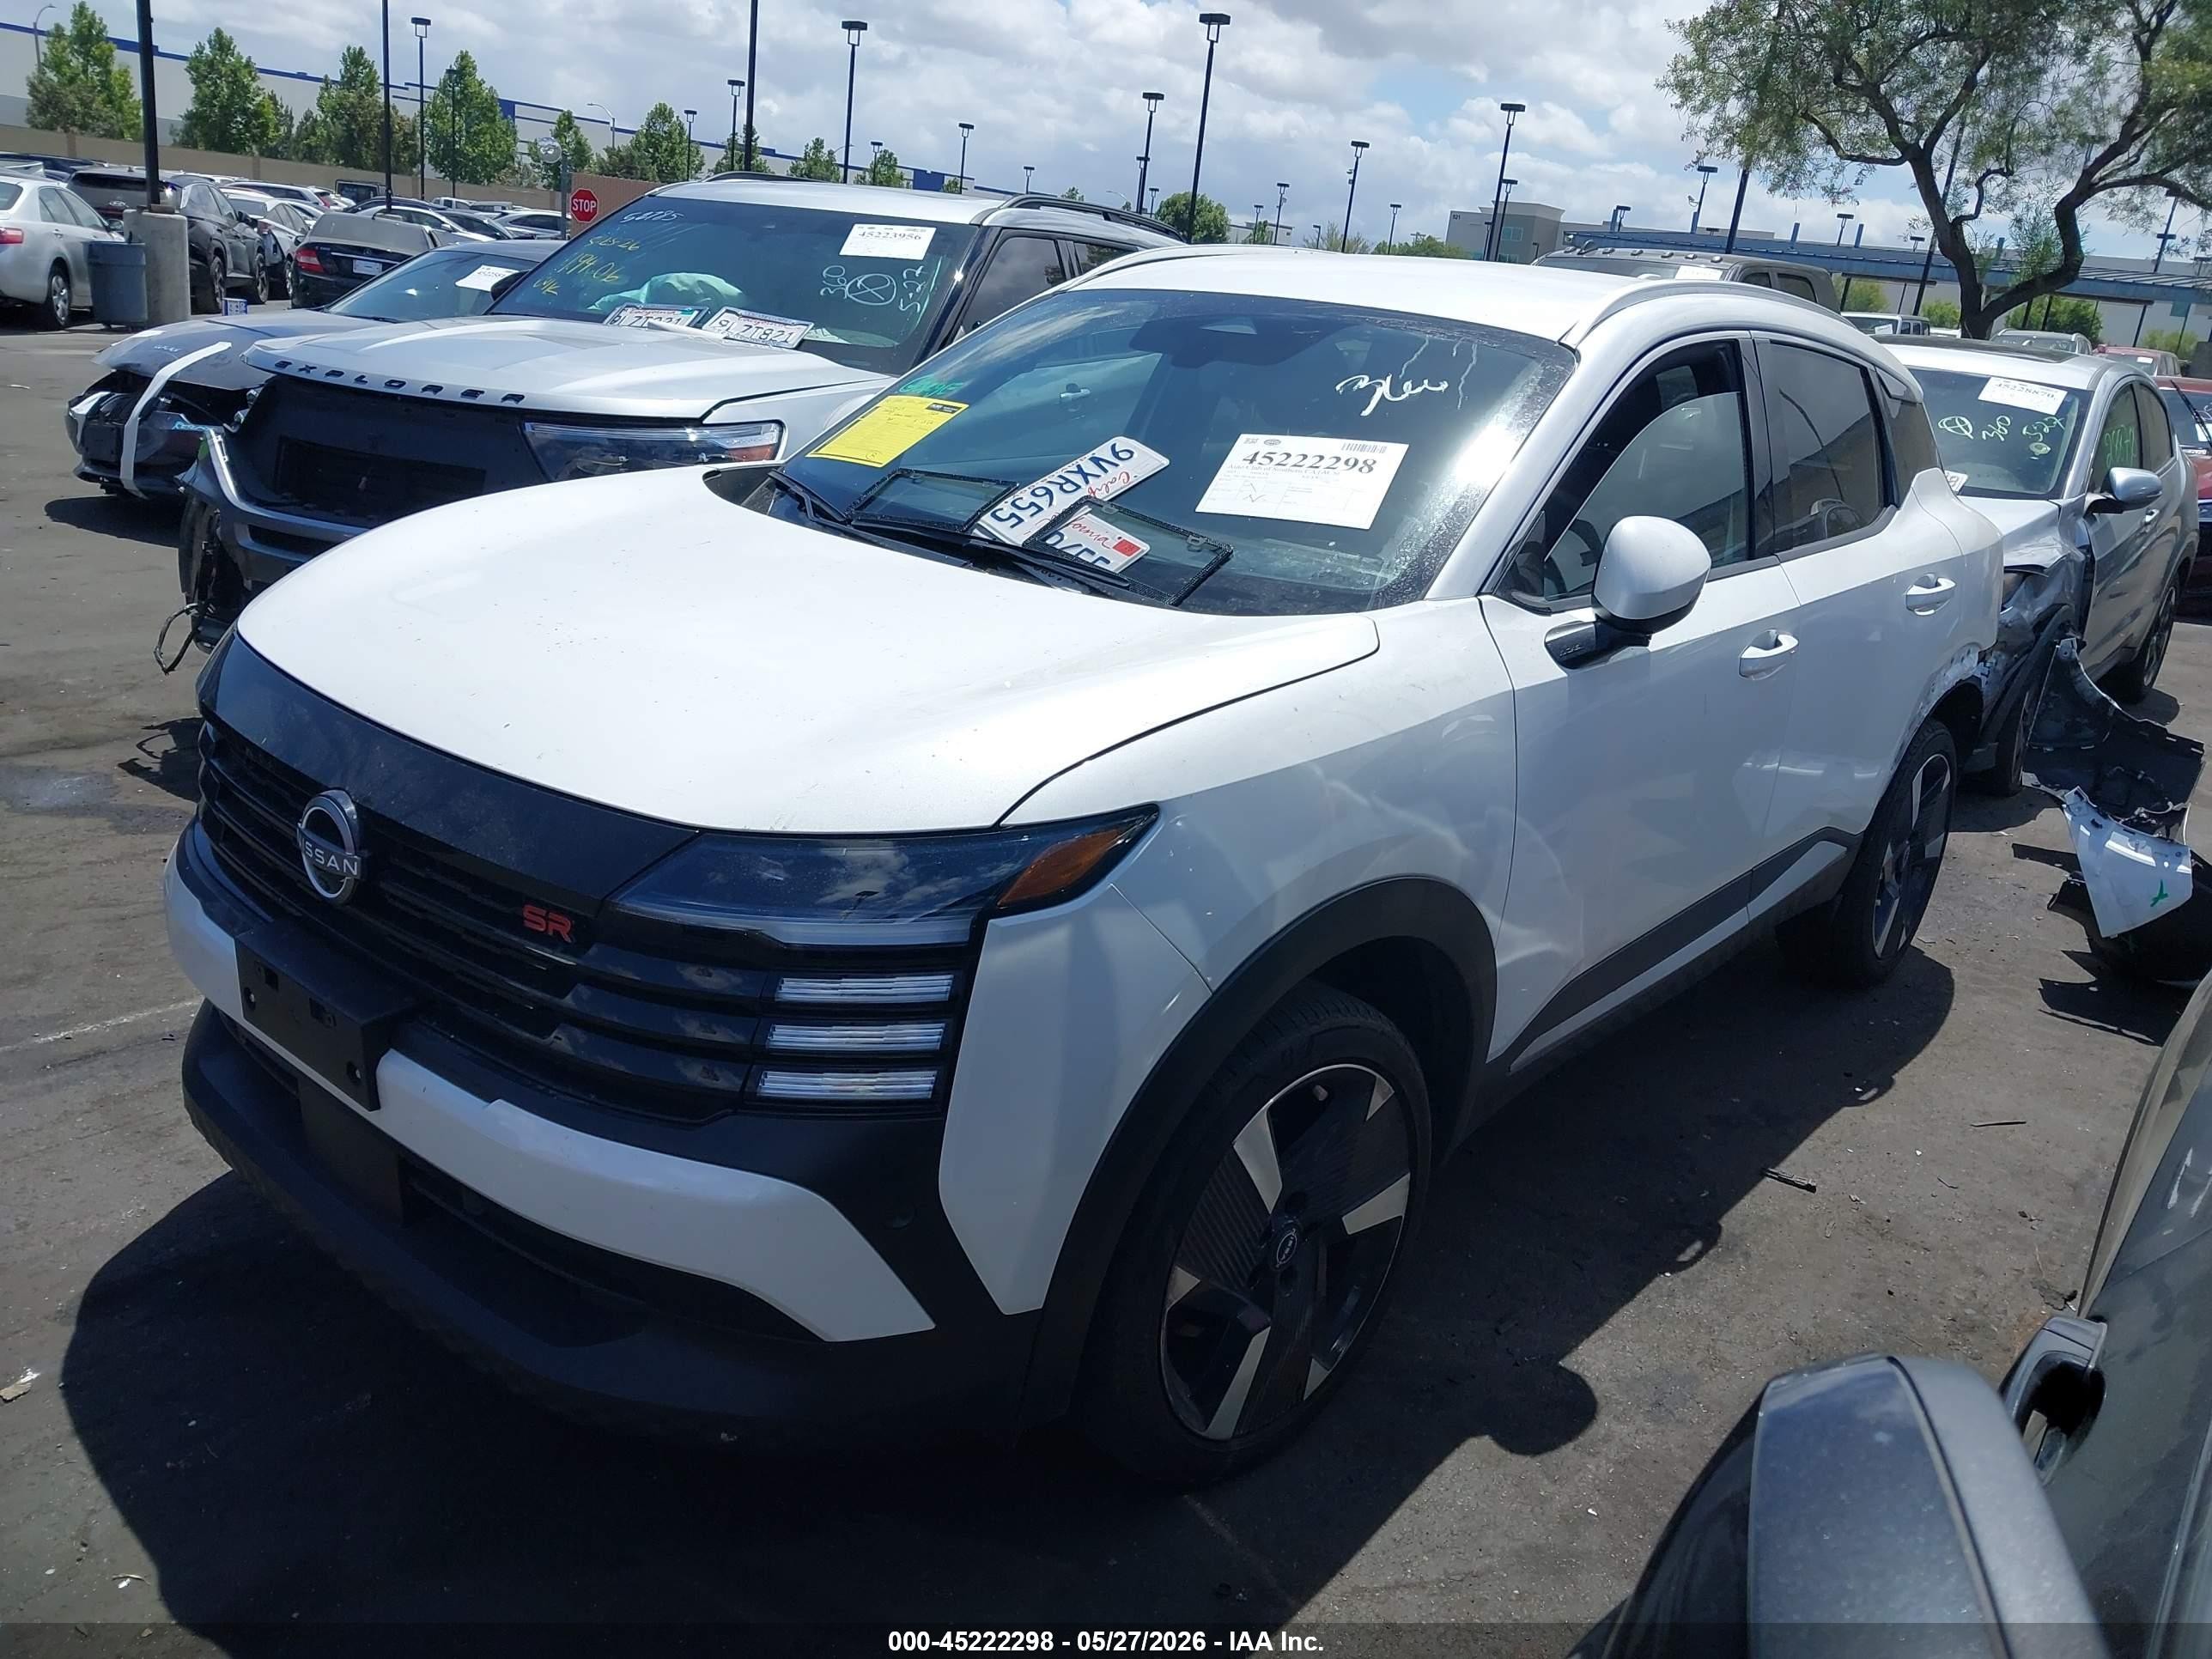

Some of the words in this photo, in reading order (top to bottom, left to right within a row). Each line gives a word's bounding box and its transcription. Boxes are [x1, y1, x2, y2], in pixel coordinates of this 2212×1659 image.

[572, 198, 597, 213] STOP
[859, 231, 921, 240] 45223956
[820, 264, 848, 300] 360
[274, 359, 526, 404] EXPLORER
[1982, 415, 2012, 442] 360
[1243, 450, 1377, 474] 45222298
[989, 442, 1135, 529] 9VXR655
[522, 904, 574, 943] SR
